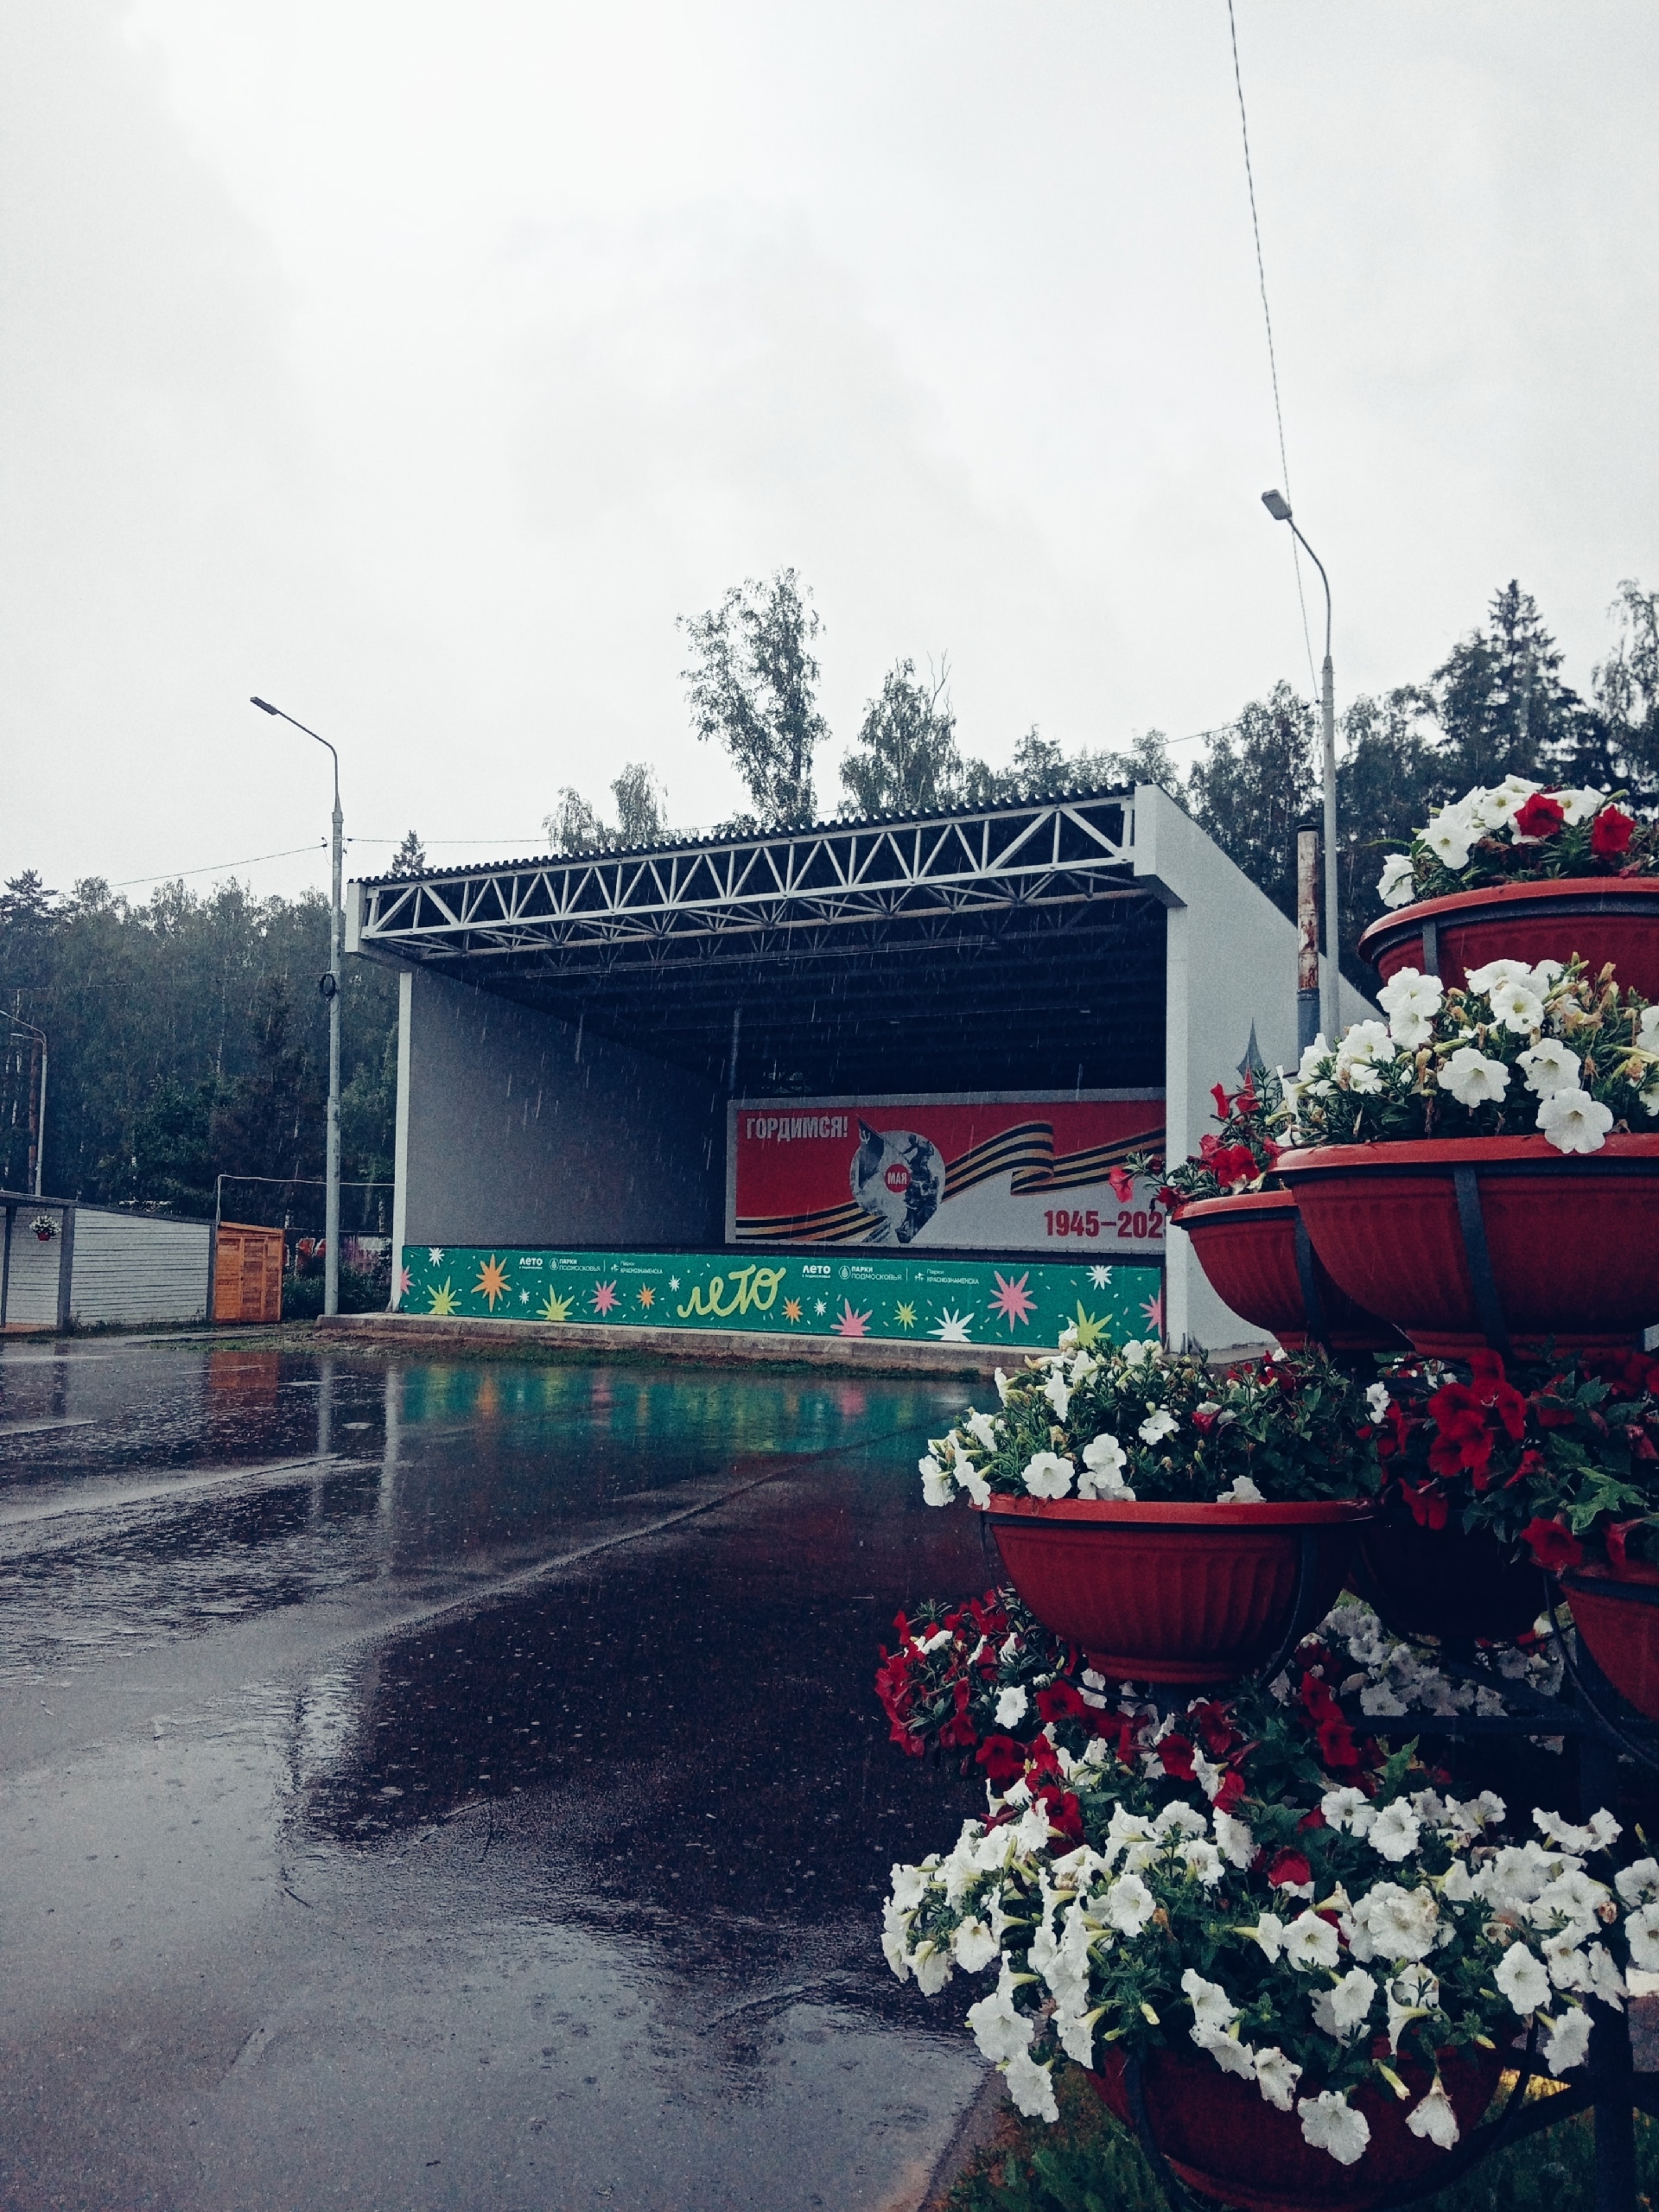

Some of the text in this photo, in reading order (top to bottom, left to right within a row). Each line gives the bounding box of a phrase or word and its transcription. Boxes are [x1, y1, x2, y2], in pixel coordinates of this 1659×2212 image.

[747, 1116, 849, 1141] ГОРДИМСЯ!
[887, 1171, 908, 1185] МАЯ
[1044, 1210, 1166, 1239] 1945-202
